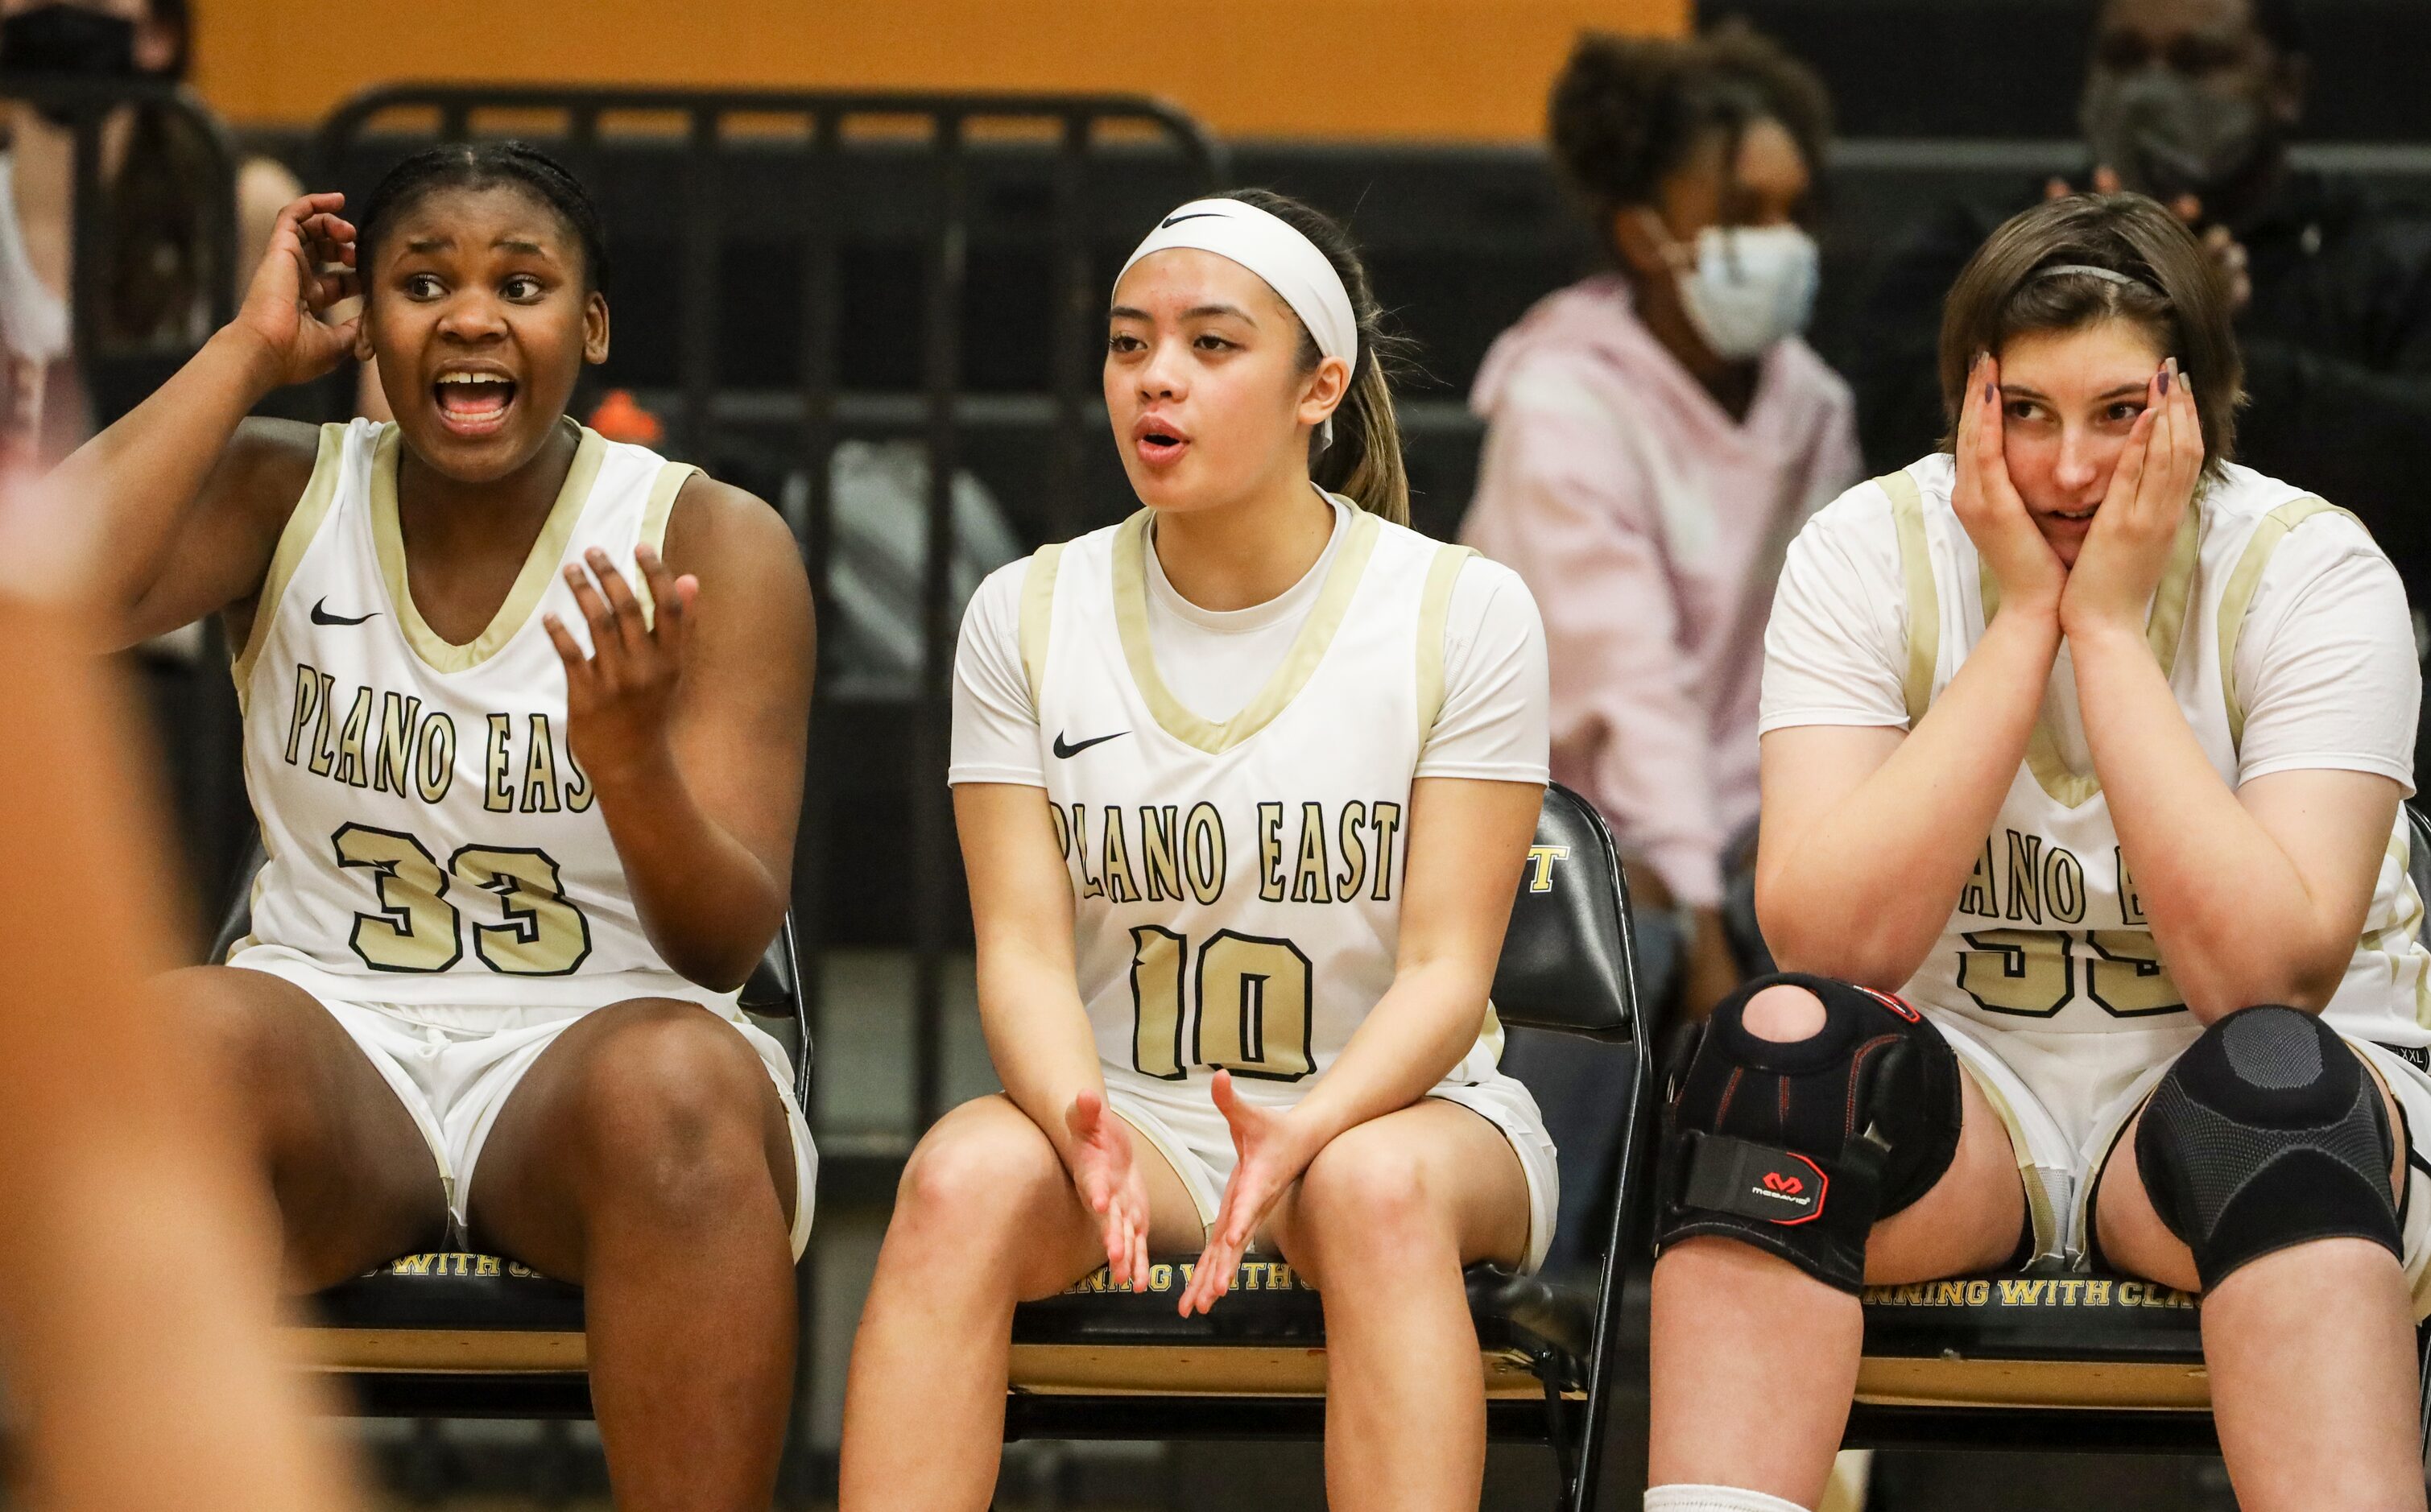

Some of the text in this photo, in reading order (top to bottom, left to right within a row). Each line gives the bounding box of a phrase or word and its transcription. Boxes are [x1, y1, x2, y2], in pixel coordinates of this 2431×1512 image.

[284, 663, 457, 804] PLANO
[1256, 801, 1401, 903] EAST
[1526, 844, 1570, 894] T
[330, 820, 593, 977] 33
[1128, 923, 1317, 1083] 10
[2400, 1047, 2424, 1064] XXL
[391, 1253, 502, 1277] WITH
[1997, 1279, 2111, 1307] WITH
